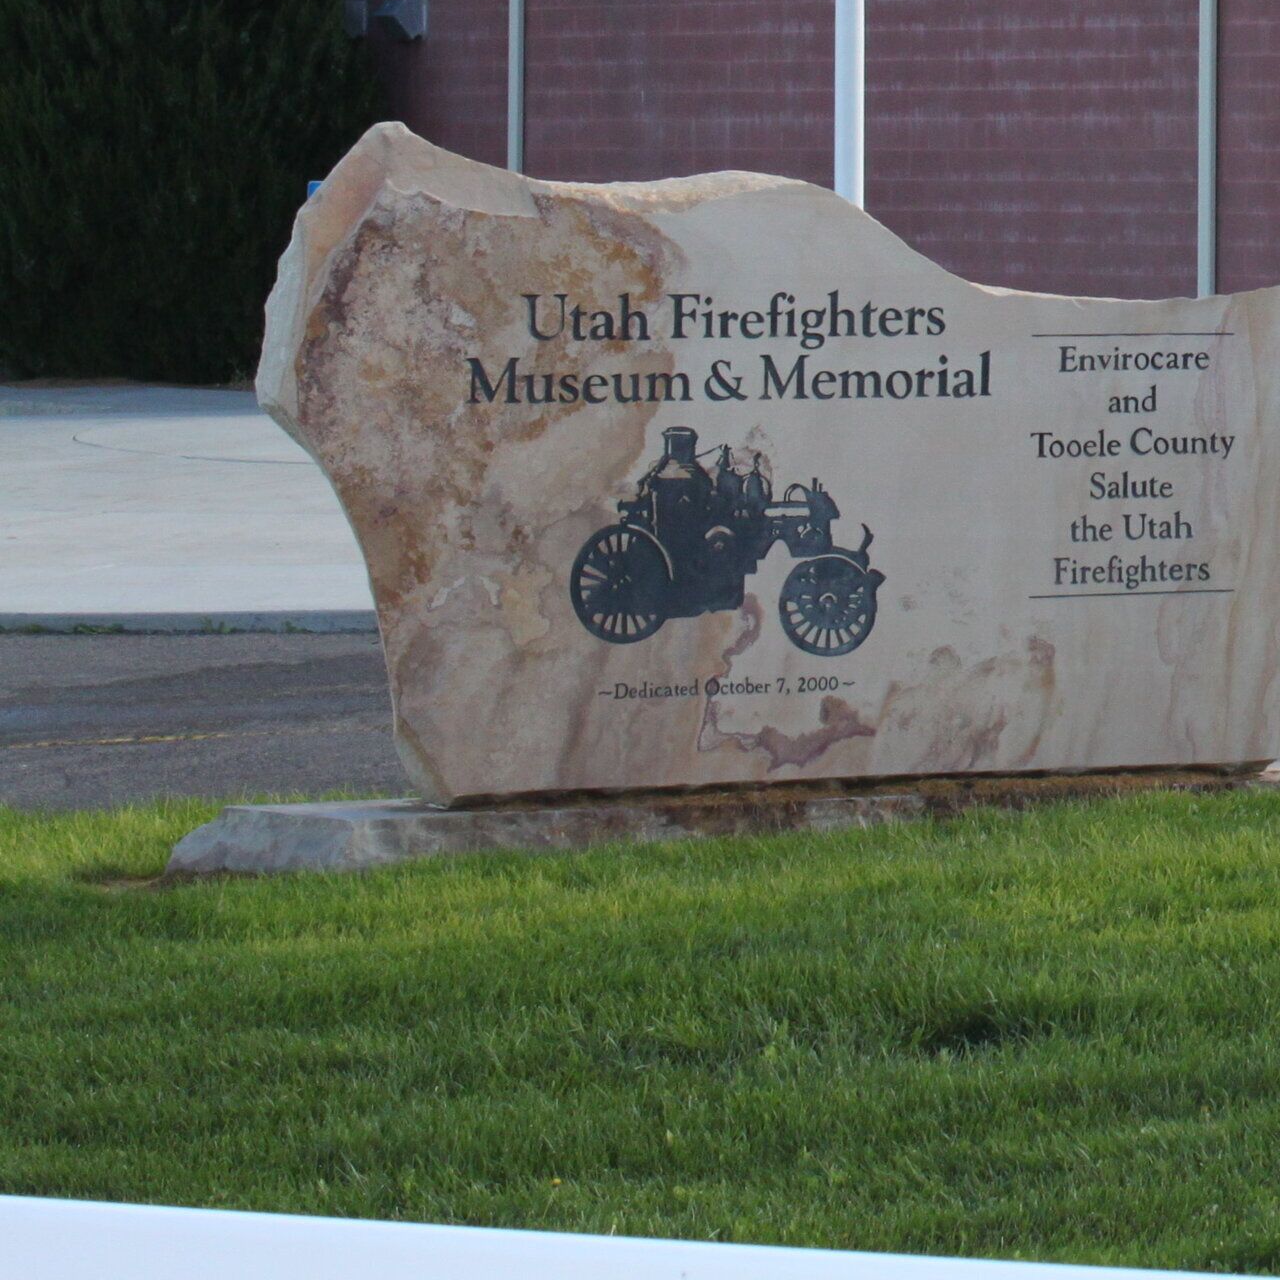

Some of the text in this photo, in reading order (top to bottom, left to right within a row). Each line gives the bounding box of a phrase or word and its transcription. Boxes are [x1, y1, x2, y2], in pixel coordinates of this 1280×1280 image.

[521, 290, 946, 349] Utah Firefighters
[1058, 345, 1210, 373] Envirocare
[466, 350, 993, 404] Museum & Memorial
[1108, 384, 1157, 413] and
[1030, 426, 1236, 460] Tooele County
[1089, 470, 1174, 500] Salute
[1070, 511, 1194, 543] the Utah
[1053, 555, 1210, 590] Firefighters
[704, 676, 771, 696] October
[776, 678, 791, 694] 7,
